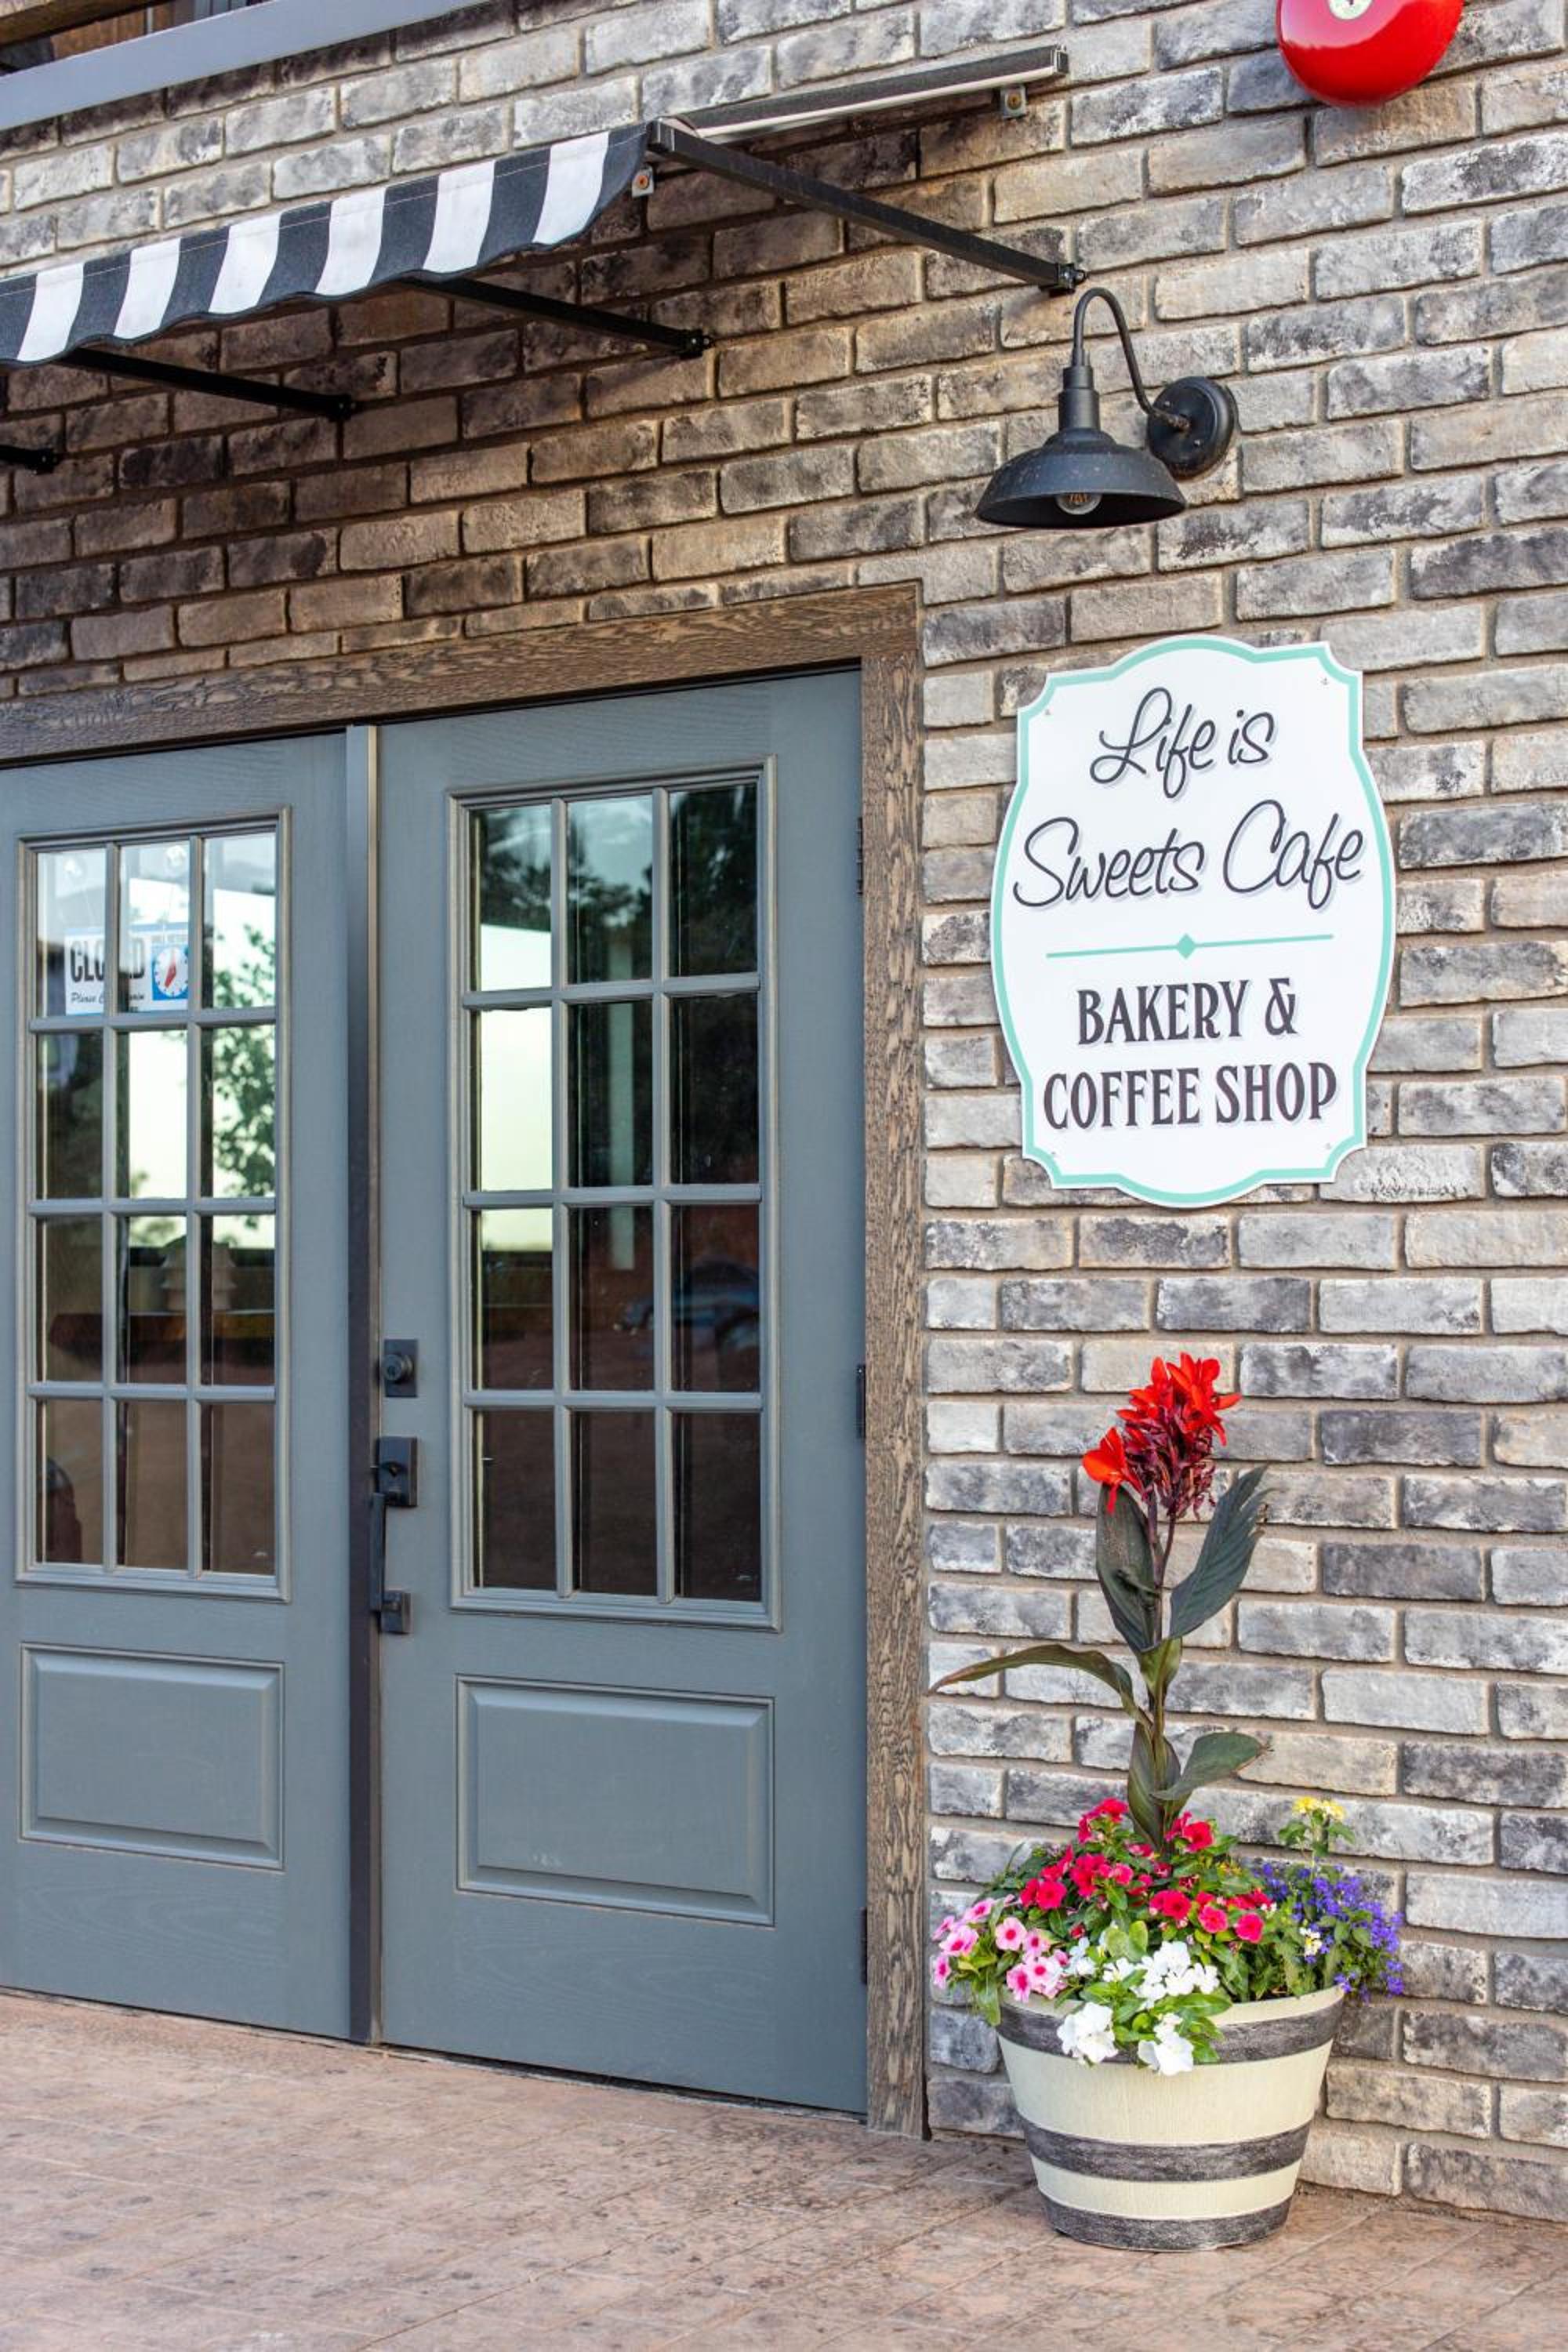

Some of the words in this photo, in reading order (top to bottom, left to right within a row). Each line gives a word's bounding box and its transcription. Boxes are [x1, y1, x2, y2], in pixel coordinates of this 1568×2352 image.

[1089, 687, 1216, 799] Life
[1228, 710, 1276, 765] is
[1012, 817, 1205, 907] Sweets
[1223, 799, 1363, 910] Cafe
[1077, 979, 1250, 1045] BAKERY
[1265, 978, 1298, 1036] &
[1044, 1067, 1200, 1130] COFFEE
[1216, 1062, 1338, 1123] SHOP
